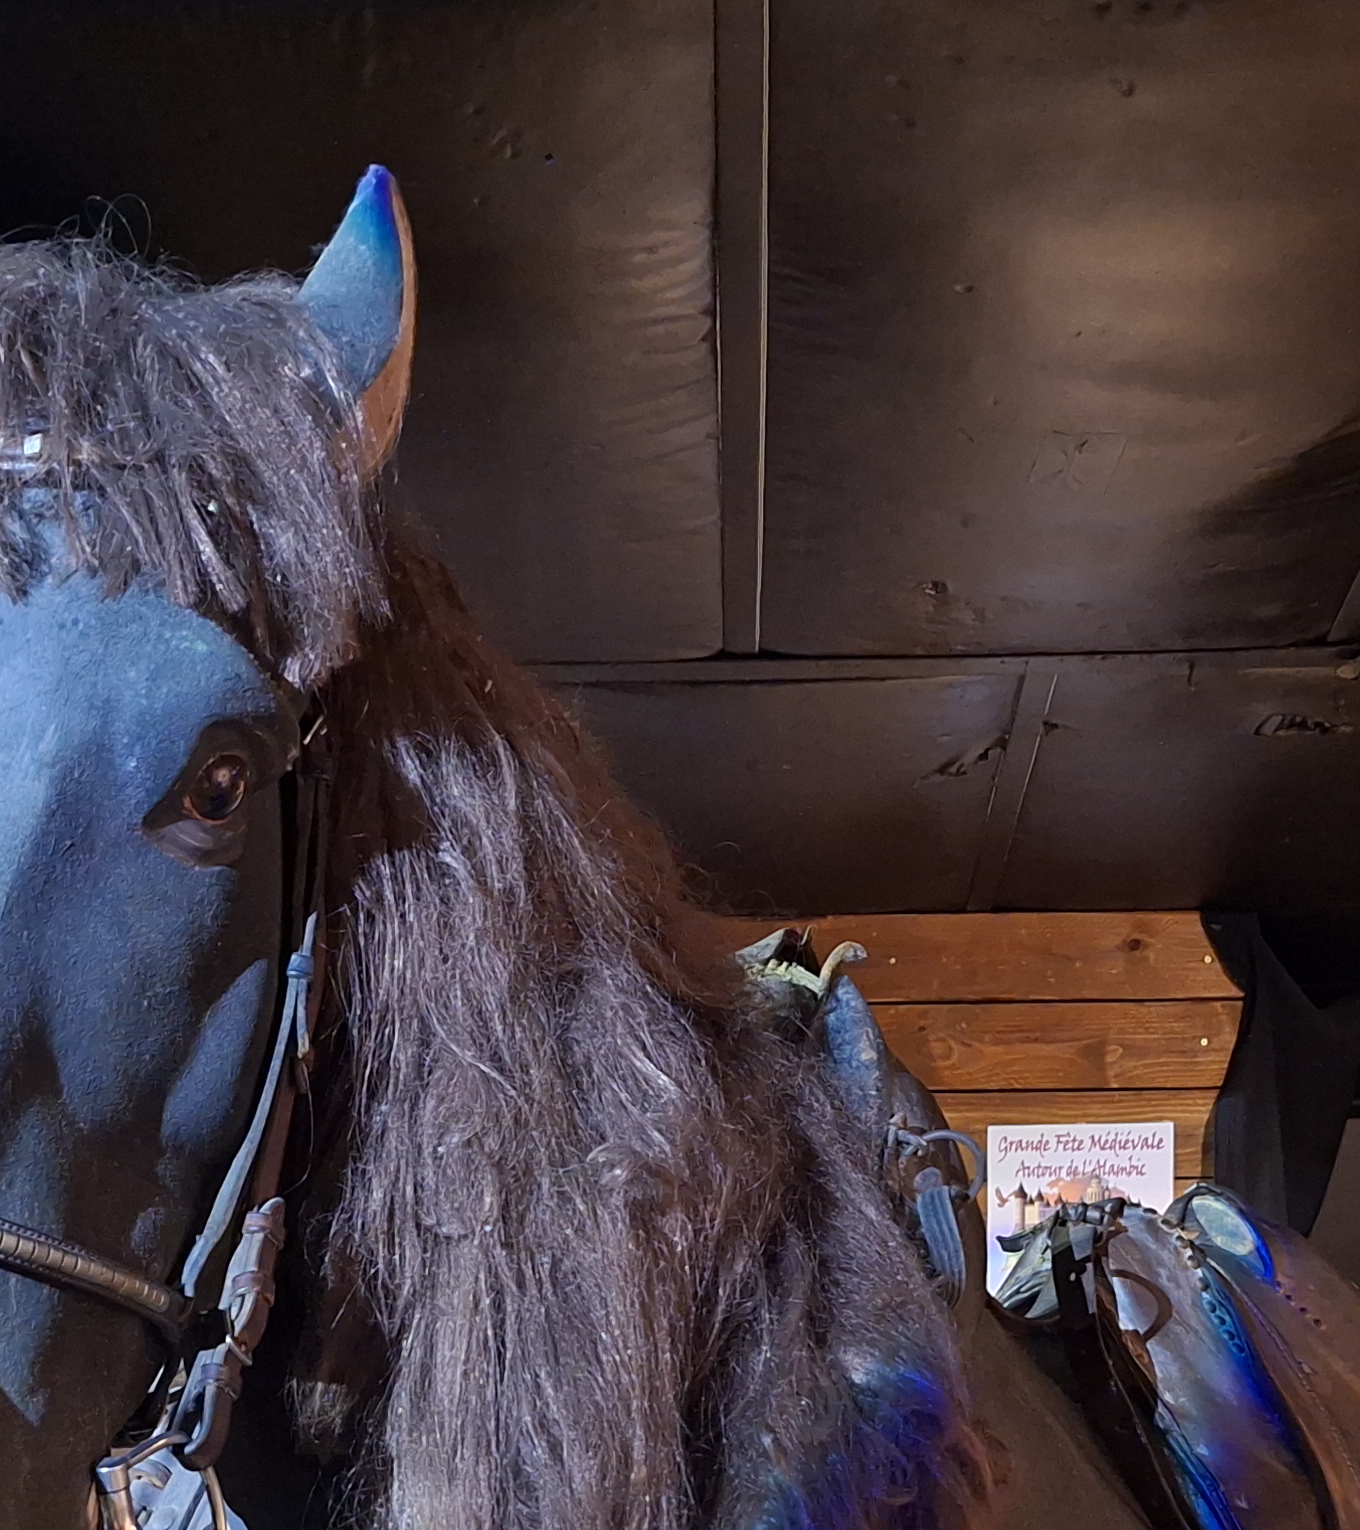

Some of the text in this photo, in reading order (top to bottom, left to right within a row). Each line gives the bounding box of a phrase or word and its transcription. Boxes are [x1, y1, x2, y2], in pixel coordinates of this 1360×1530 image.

[998, 1130, 1164, 1162] Grande Fête Médiévale
[1015, 1160, 1064, 1178] Autour
[1066, 1160, 1079, 1178] de
